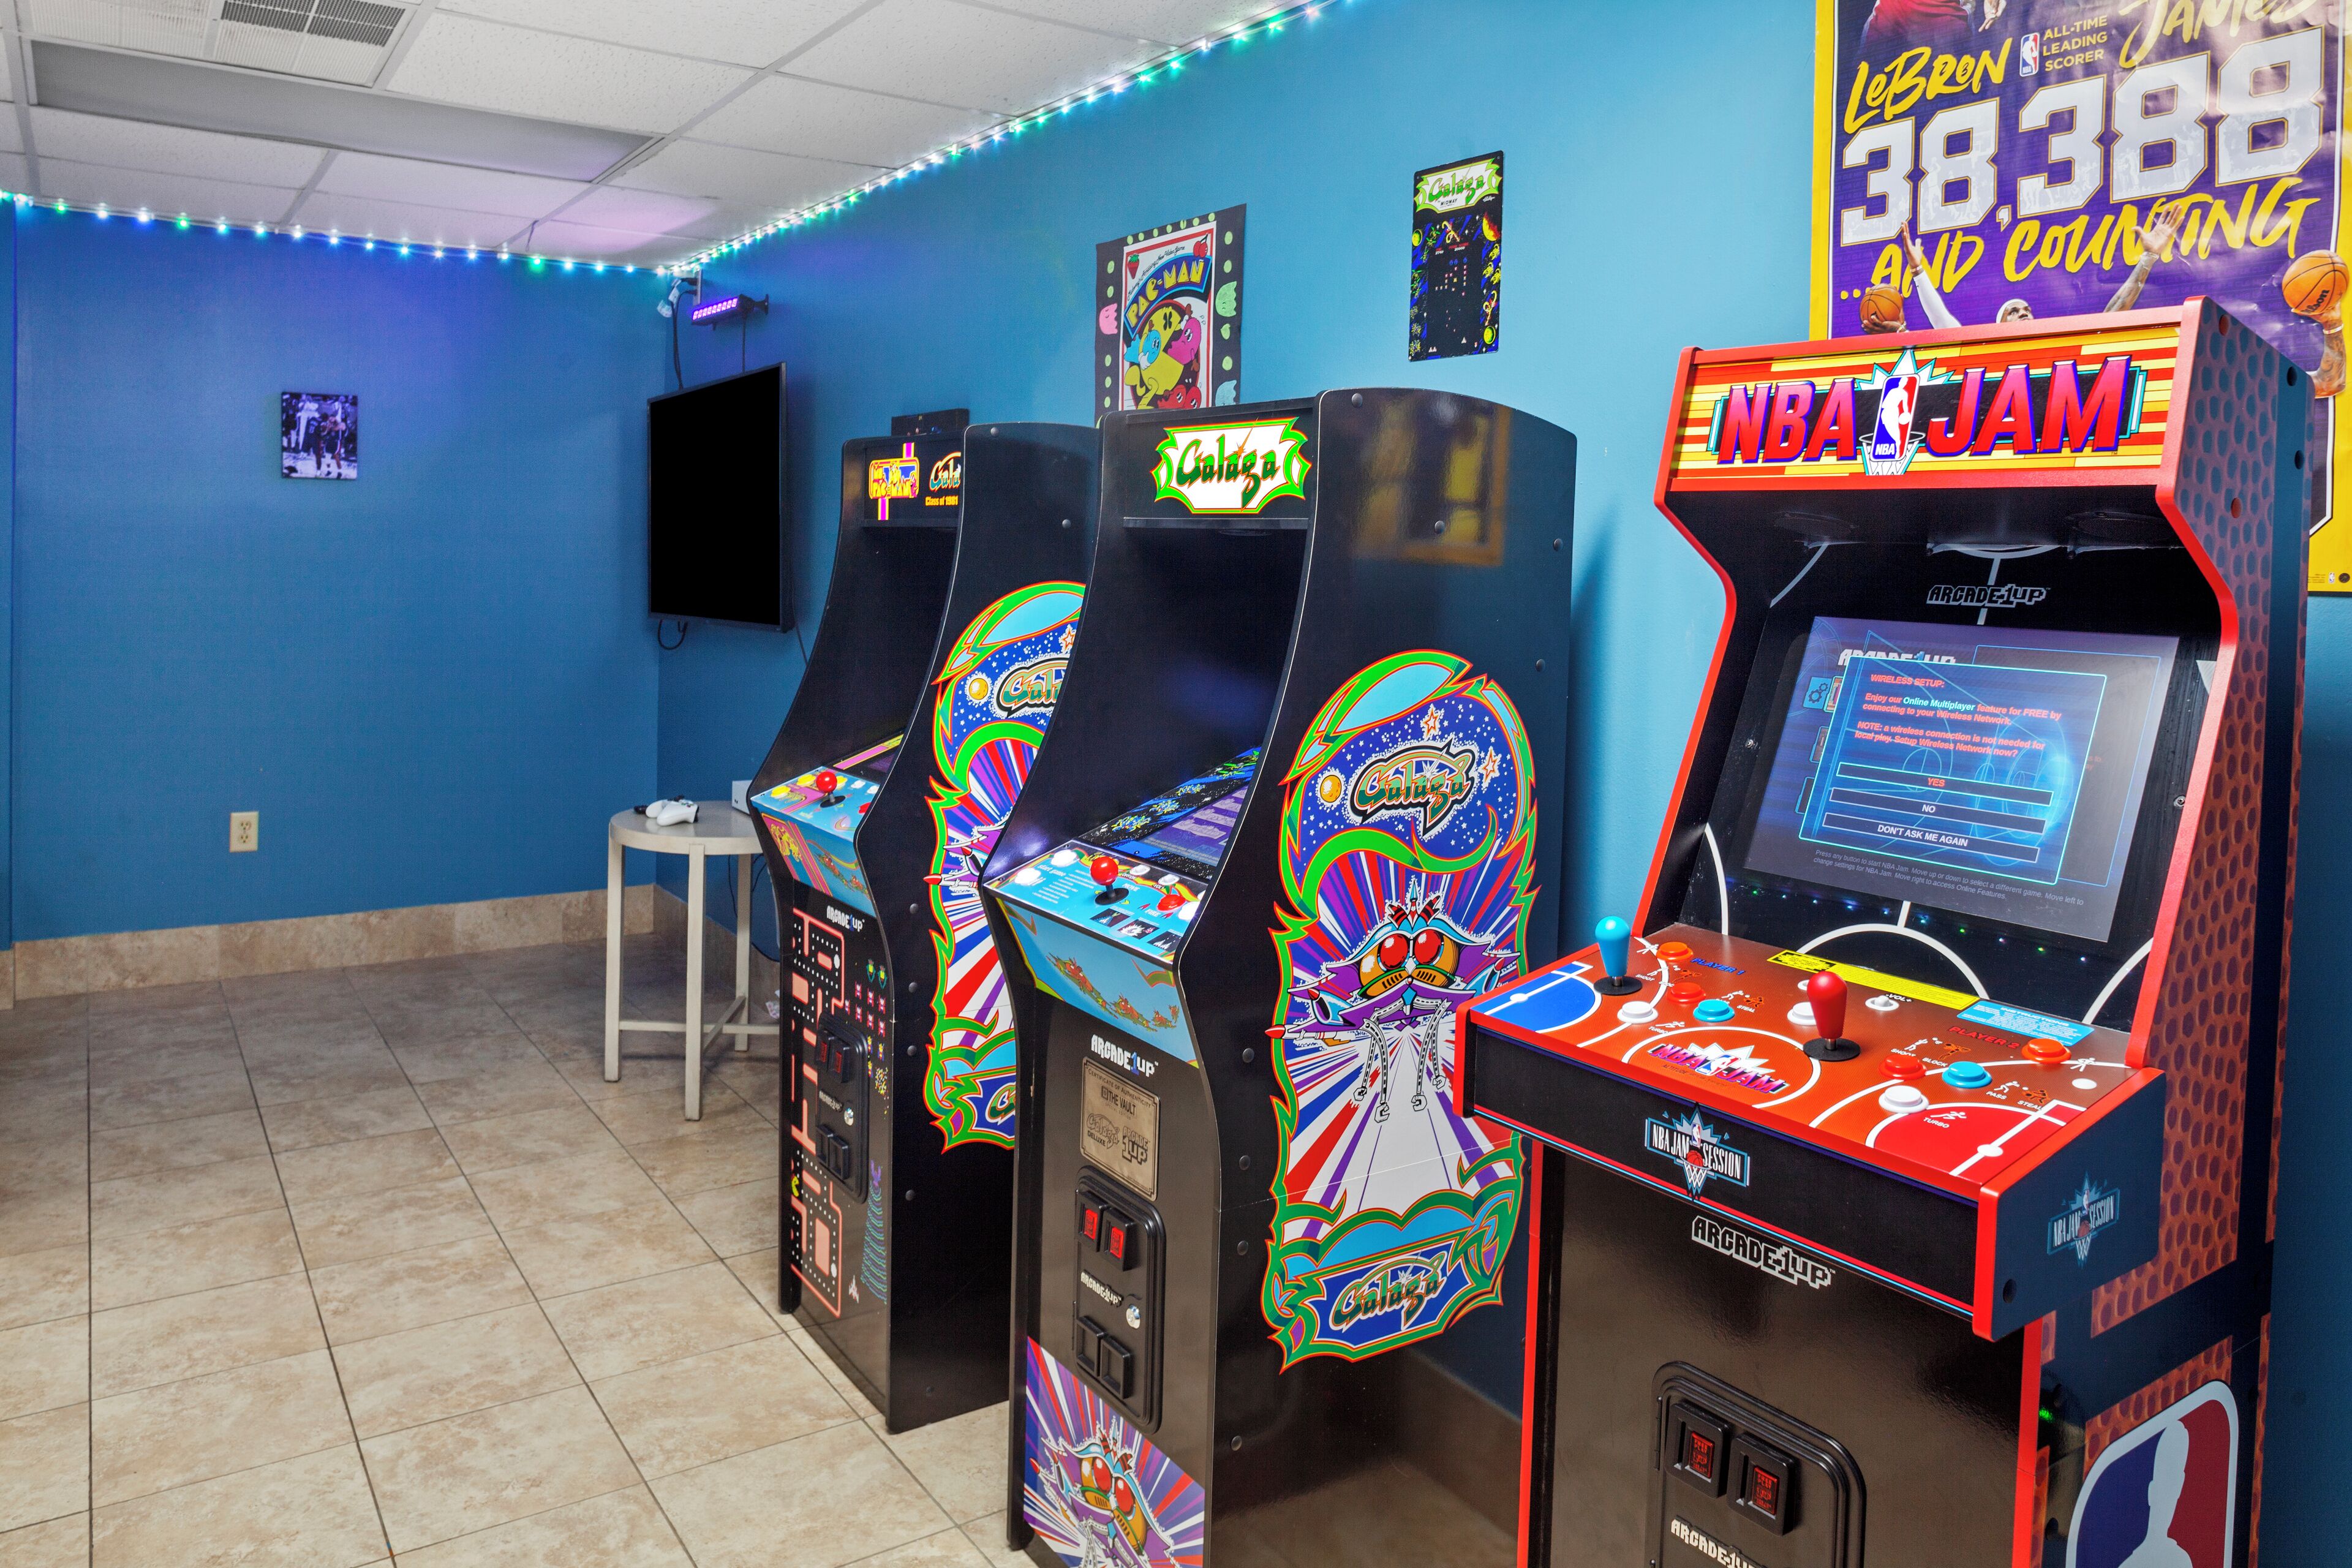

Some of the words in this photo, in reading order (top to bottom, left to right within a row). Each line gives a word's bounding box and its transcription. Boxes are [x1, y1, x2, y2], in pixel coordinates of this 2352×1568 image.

[2043, 15, 2108, 40] ALL-TIME
[2043, 32, 2107, 56] LEADING
[2045, 49, 2105, 72] SCORER
[1841, 25, 2326, 246] 38,388
[1428, 173, 1486, 206] Galaga
[2003, 178, 2321, 281] COUNTING
[1126, 259, 1204, 328] PAC-MAN
[1717, 377, 1856, 465] NBA
[1924, 355, 2132, 458] JAM
[1875, 443, 1895, 456] NBA
[1176, 434, 1280, 513] Galaga
[925, 496, 939, 506] Class
[939, 496, 945, 506] of
[945, 495, 959, 505] 1981
[1871, 674, 1912, 685] WIRELESS
[1914, 678, 1945, 688] SETUP:
[1863, 704, 1905, 715] connecting
[1917, 709, 1934, 717] your
[1937, 710, 1972, 721] Wireless
[1973, 715, 2012, 725] Network.
[1865, 693, 1887, 704] Enjoy
[1903, 697, 1929, 706] Online
[1930, 700, 1975, 712] Multiplayer
[1977, 704, 2007, 714] feature
[2008, 706, 2021, 715] for
[2023, 709, 2048, 718] FREE
[2049, 711, 2062, 721] by
[1855, 731, 1873, 740] local
[1874, 733, 1892, 743] play.
[1894, 735, 1917, 747] Setup
[1919, 738, 1954, 750] Wireless
[1956, 741, 1991, 754] Network
[1993, 748, 2018, 757] now?
[1857, 721, 1882, 731] NOTE:
[1890, 726, 1923, 736] wireless
[1925, 730, 1970, 742] connection
[1973, 734, 1980, 742] is
[1982, 735, 1997, 744] not
[1999, 738, 2030, 748] needed
[2032, 741, 2045, 750] for
[1355, 750, 1472, 824] Galaga
[1928, 777, 1945, 787] YES
[1922, 804, 1936, 813] NO
[1877, 824, 1904, 835] DON'T
[1904, 828, 1923, 839] ASK
[1924, 832, 1939, 842] ME
[1939, 835, 1968, 847] AGAIN
[1814, 858, 1833, 867] change
[1834, 861, 1855, 870] settings
[1879, 869, 1893, 878] Jam.
[1932, 880, 1955, 889] access
[1956, 884, 1976, 893] Online
[1977, 888, 2007, 899] Features.
[1815, 850, 1831, 858] Press
[1843, 854, 1860, 863] button
[1868, 859, 1881, 867] start
[1896, 864, 1909, 873] Jam.
[1911, 867, 1928, 876] Move
[1945, 873, 1961, 882] down
[1970, 878, 1989, 888] select
[1996, 883, 2022, 894] different
[2023, 889, 2043, 898] game.
[2045, 892, 2063, 902] Move
[1691, 958, 1737, 973] PLAYER
[2000, 1007, 2069, 1027] INSTRUCTIONS
[1949, 1026, 2007, 1046] PLAYER
[1649, 1044, 1708, 1069] NBA
[1716, 1067, 1785, 1093] JAM
[1922, 1057, 1948, 1067] BLOCK
[1108, 1090, 1118, 1106] THE
[1120, 1096, 1136, 1115] VAULT
[1986, 1091, 2007, 1100] PASS
[2018, 1100, 2043, 1111] STEAL
[1923, 1117, 1950, 1129] TURBO
[1087, 1130, 1106, 1147] DELUXE
[1652, 1124, 1671, 1153] NBA
[1670, 1131, 1689, 1158] JAM
[1703, 1144, 1741, 1179] SESSION
[2054, 1217, 2066, 1246] NBA
[2089, 1195, 2114, 1230] SESSION
[1332, 1253, 1446, 1327] Galaga
